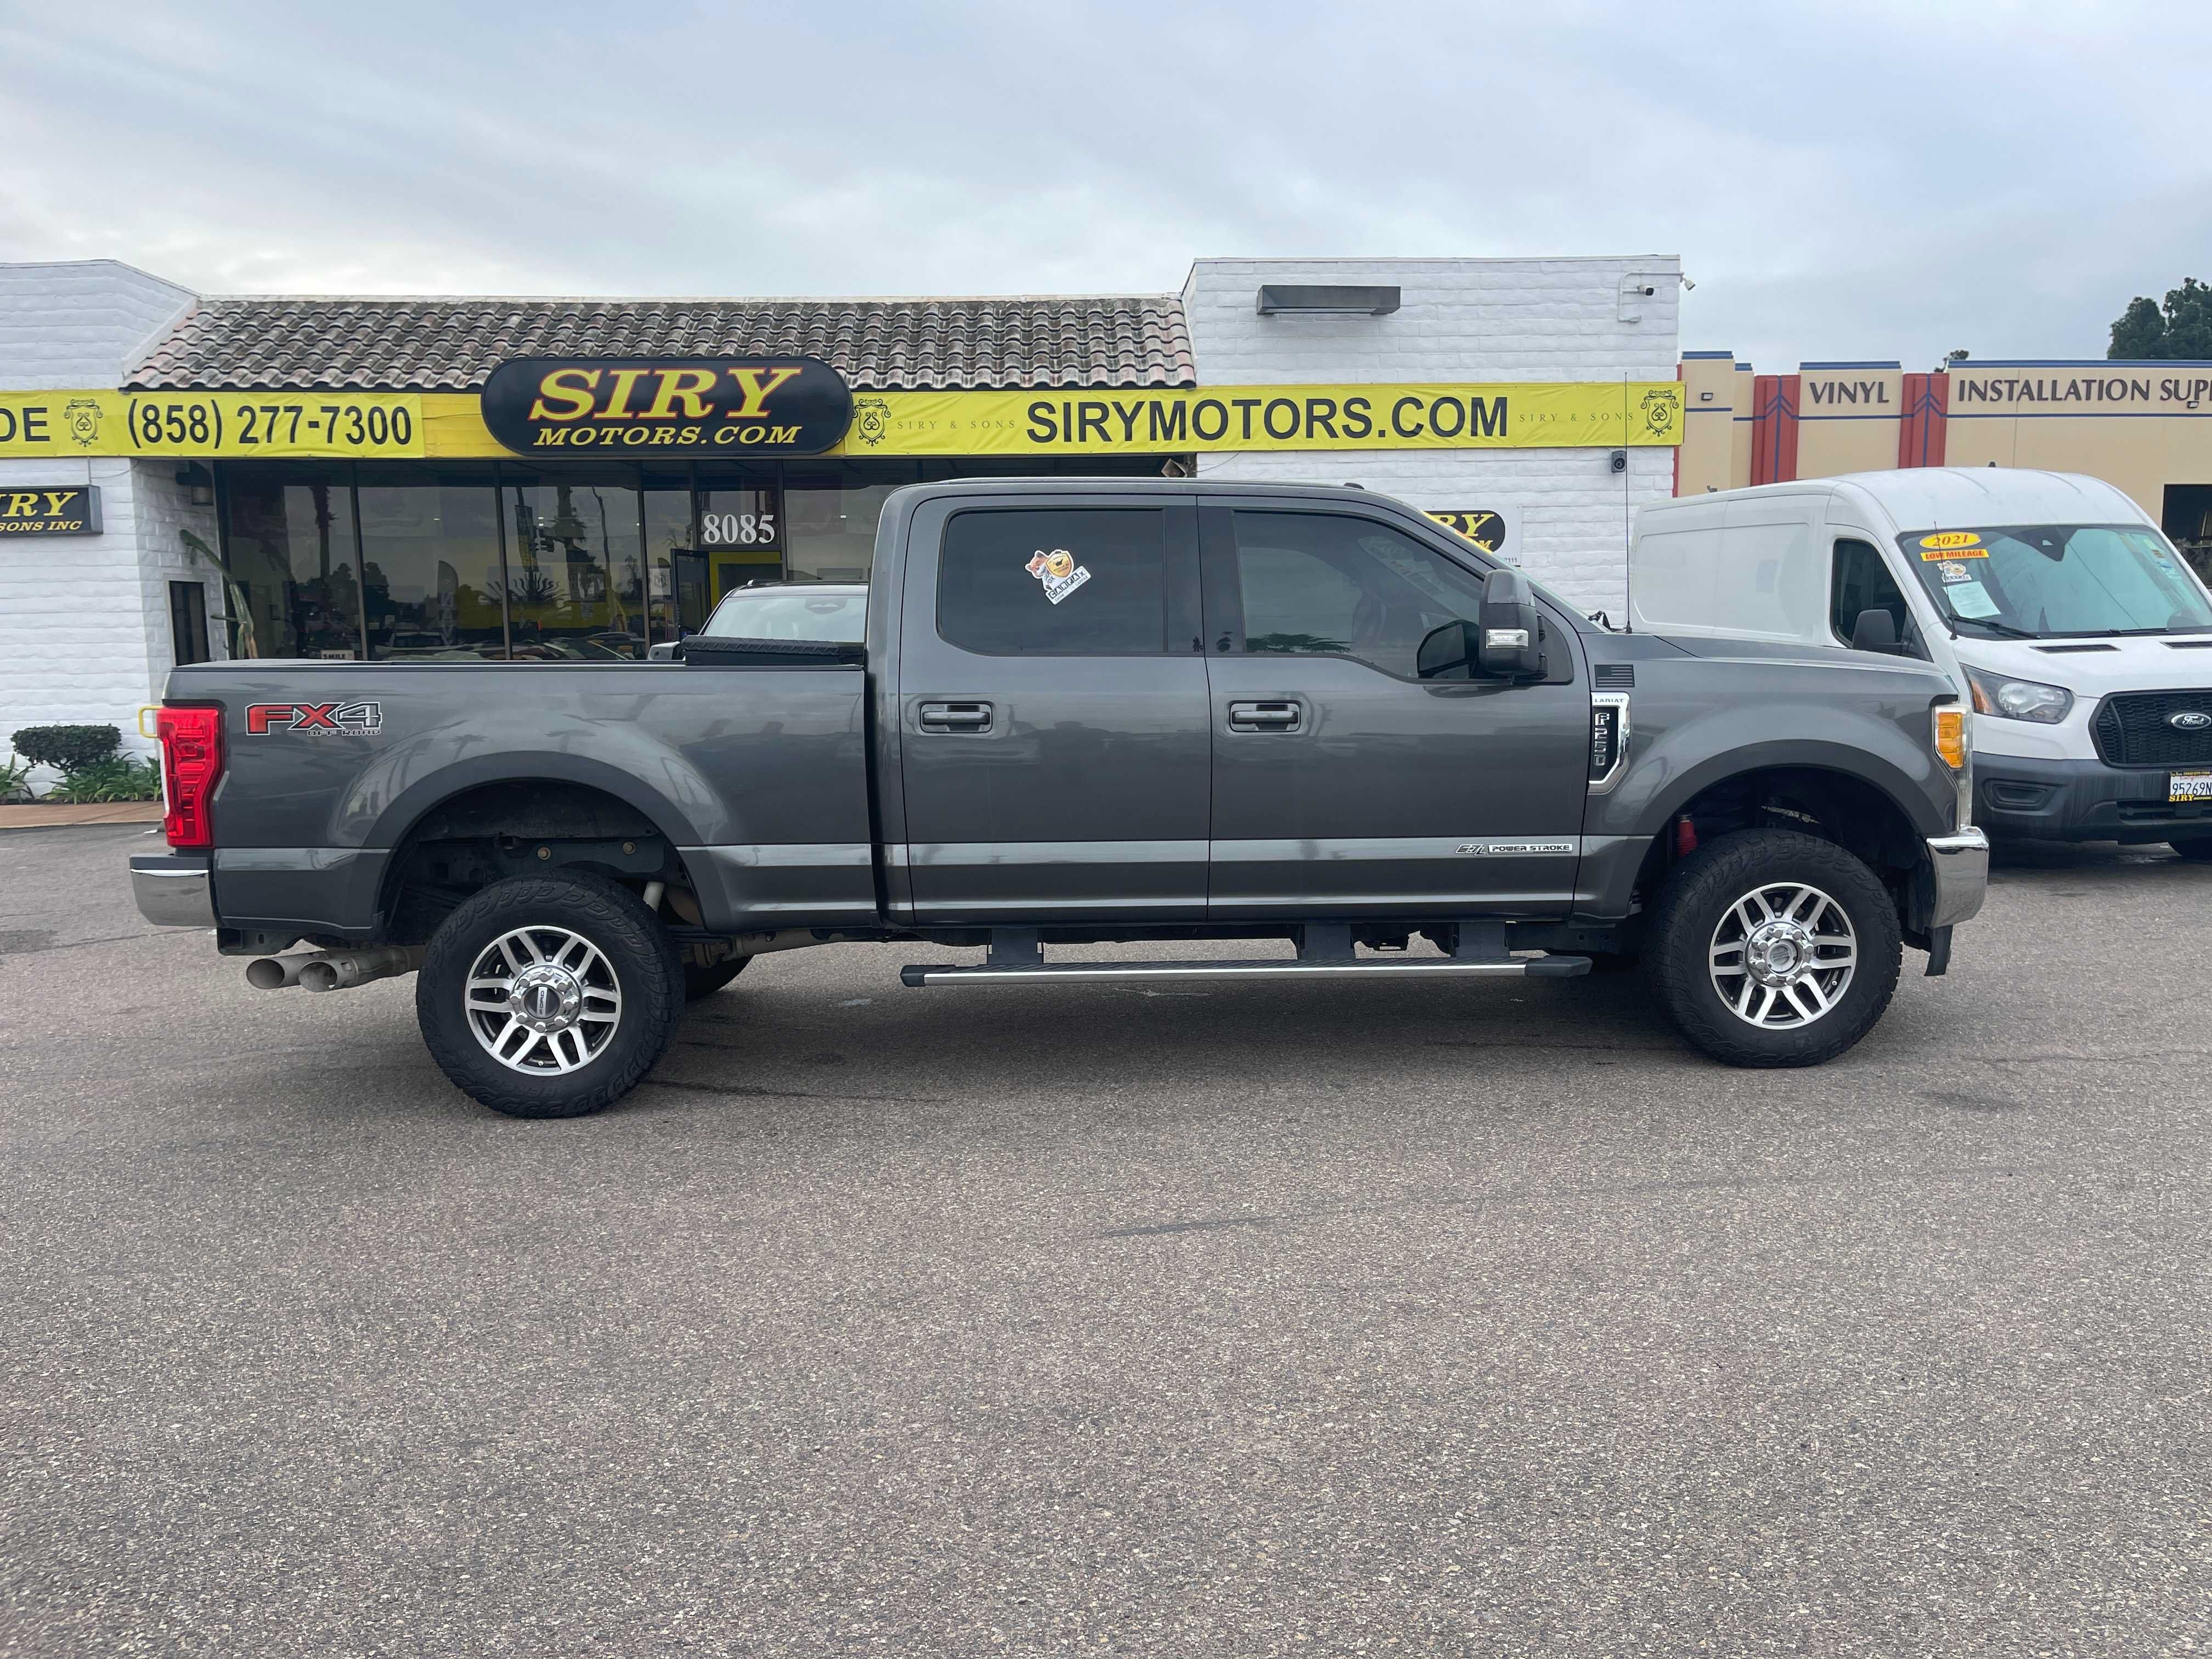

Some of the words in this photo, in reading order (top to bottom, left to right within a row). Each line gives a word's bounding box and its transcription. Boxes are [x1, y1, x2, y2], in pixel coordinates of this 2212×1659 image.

[527, 366, 803, 421] SIRY
[1809, 381, 1890, 404] VINYL
[1958, 378, 2150, 402] INSTALLATION
[2159, 379, 2212, 402] SUP
[128, 398, 223, 449] (858)
[236, 405, 411, 445] 277-7300
[897, 421, 937, 429] SIRY
[970, 420, 1015, 429] SONS
[1027, 397, 1509, 443] SIRYMOTORS.COM
[1519, 413, 1558, 422] SIRY
[1570, 413, 1577, 421] &
[1590, 413, 1634, 421] SONS
[533, 426, 802, 445] MOTORS.COM
[0, 492, 78, 517] RY
[47, 520, 83, 531] INC
[703, 514, 775, 544] 8085
[1933, 534, 1968, 546] 2021
[1048, 571, 1086, 599] CARFAX
[245, 702, 383, 736] FX4
[2182, 715, 2204, 725] Ford
